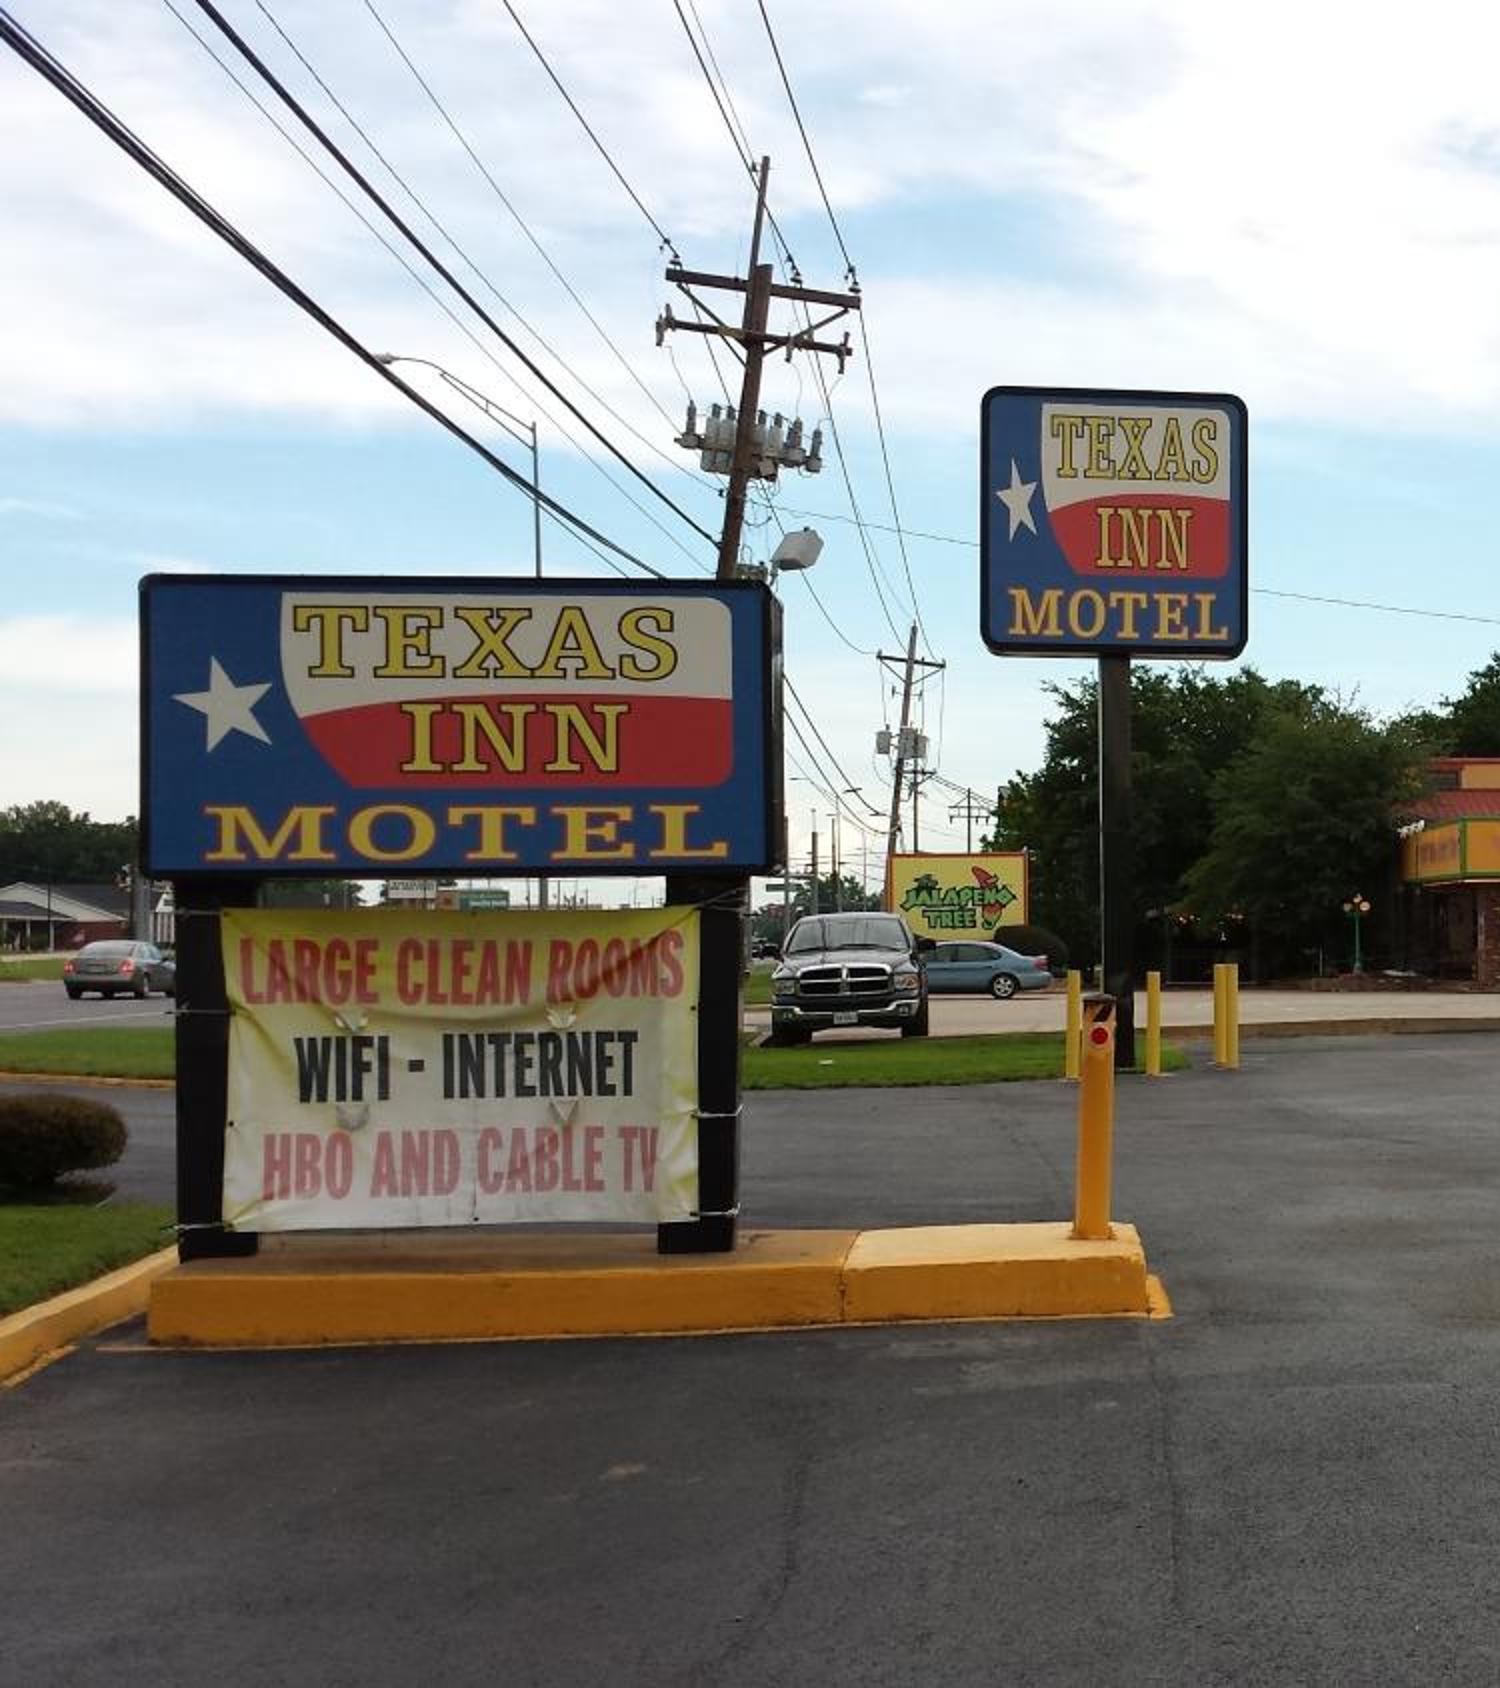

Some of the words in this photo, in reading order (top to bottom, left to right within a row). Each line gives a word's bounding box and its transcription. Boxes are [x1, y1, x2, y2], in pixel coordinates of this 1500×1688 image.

[1051, 414, 1218, 484] TEXAS
[1096, 507, 1193, 570] INN
[293, 605, 678, 680] TEXAS
[1008, 587, 1229, 641] MOTEL
[401, 703, 629, 773] INN
[204, 805, 728, 861] MOTEL
[922, 908, 977, 930] TREE
[238, 937, 381, 1005] LARGE
[397, 938, 534, 1006] CLEAN
[547, 928, 686, 1003] ROOMS
[294, 1035, 390, 1104] WIFI
[442, 1031, 639, 1100] INTERNET
[263, 1131, 354, 1200] HBO
[370, 1129, 461, 1197] AND
[477, 1126, 606, 1195] CABLE
[618, 1126, 660, 1192] TV
